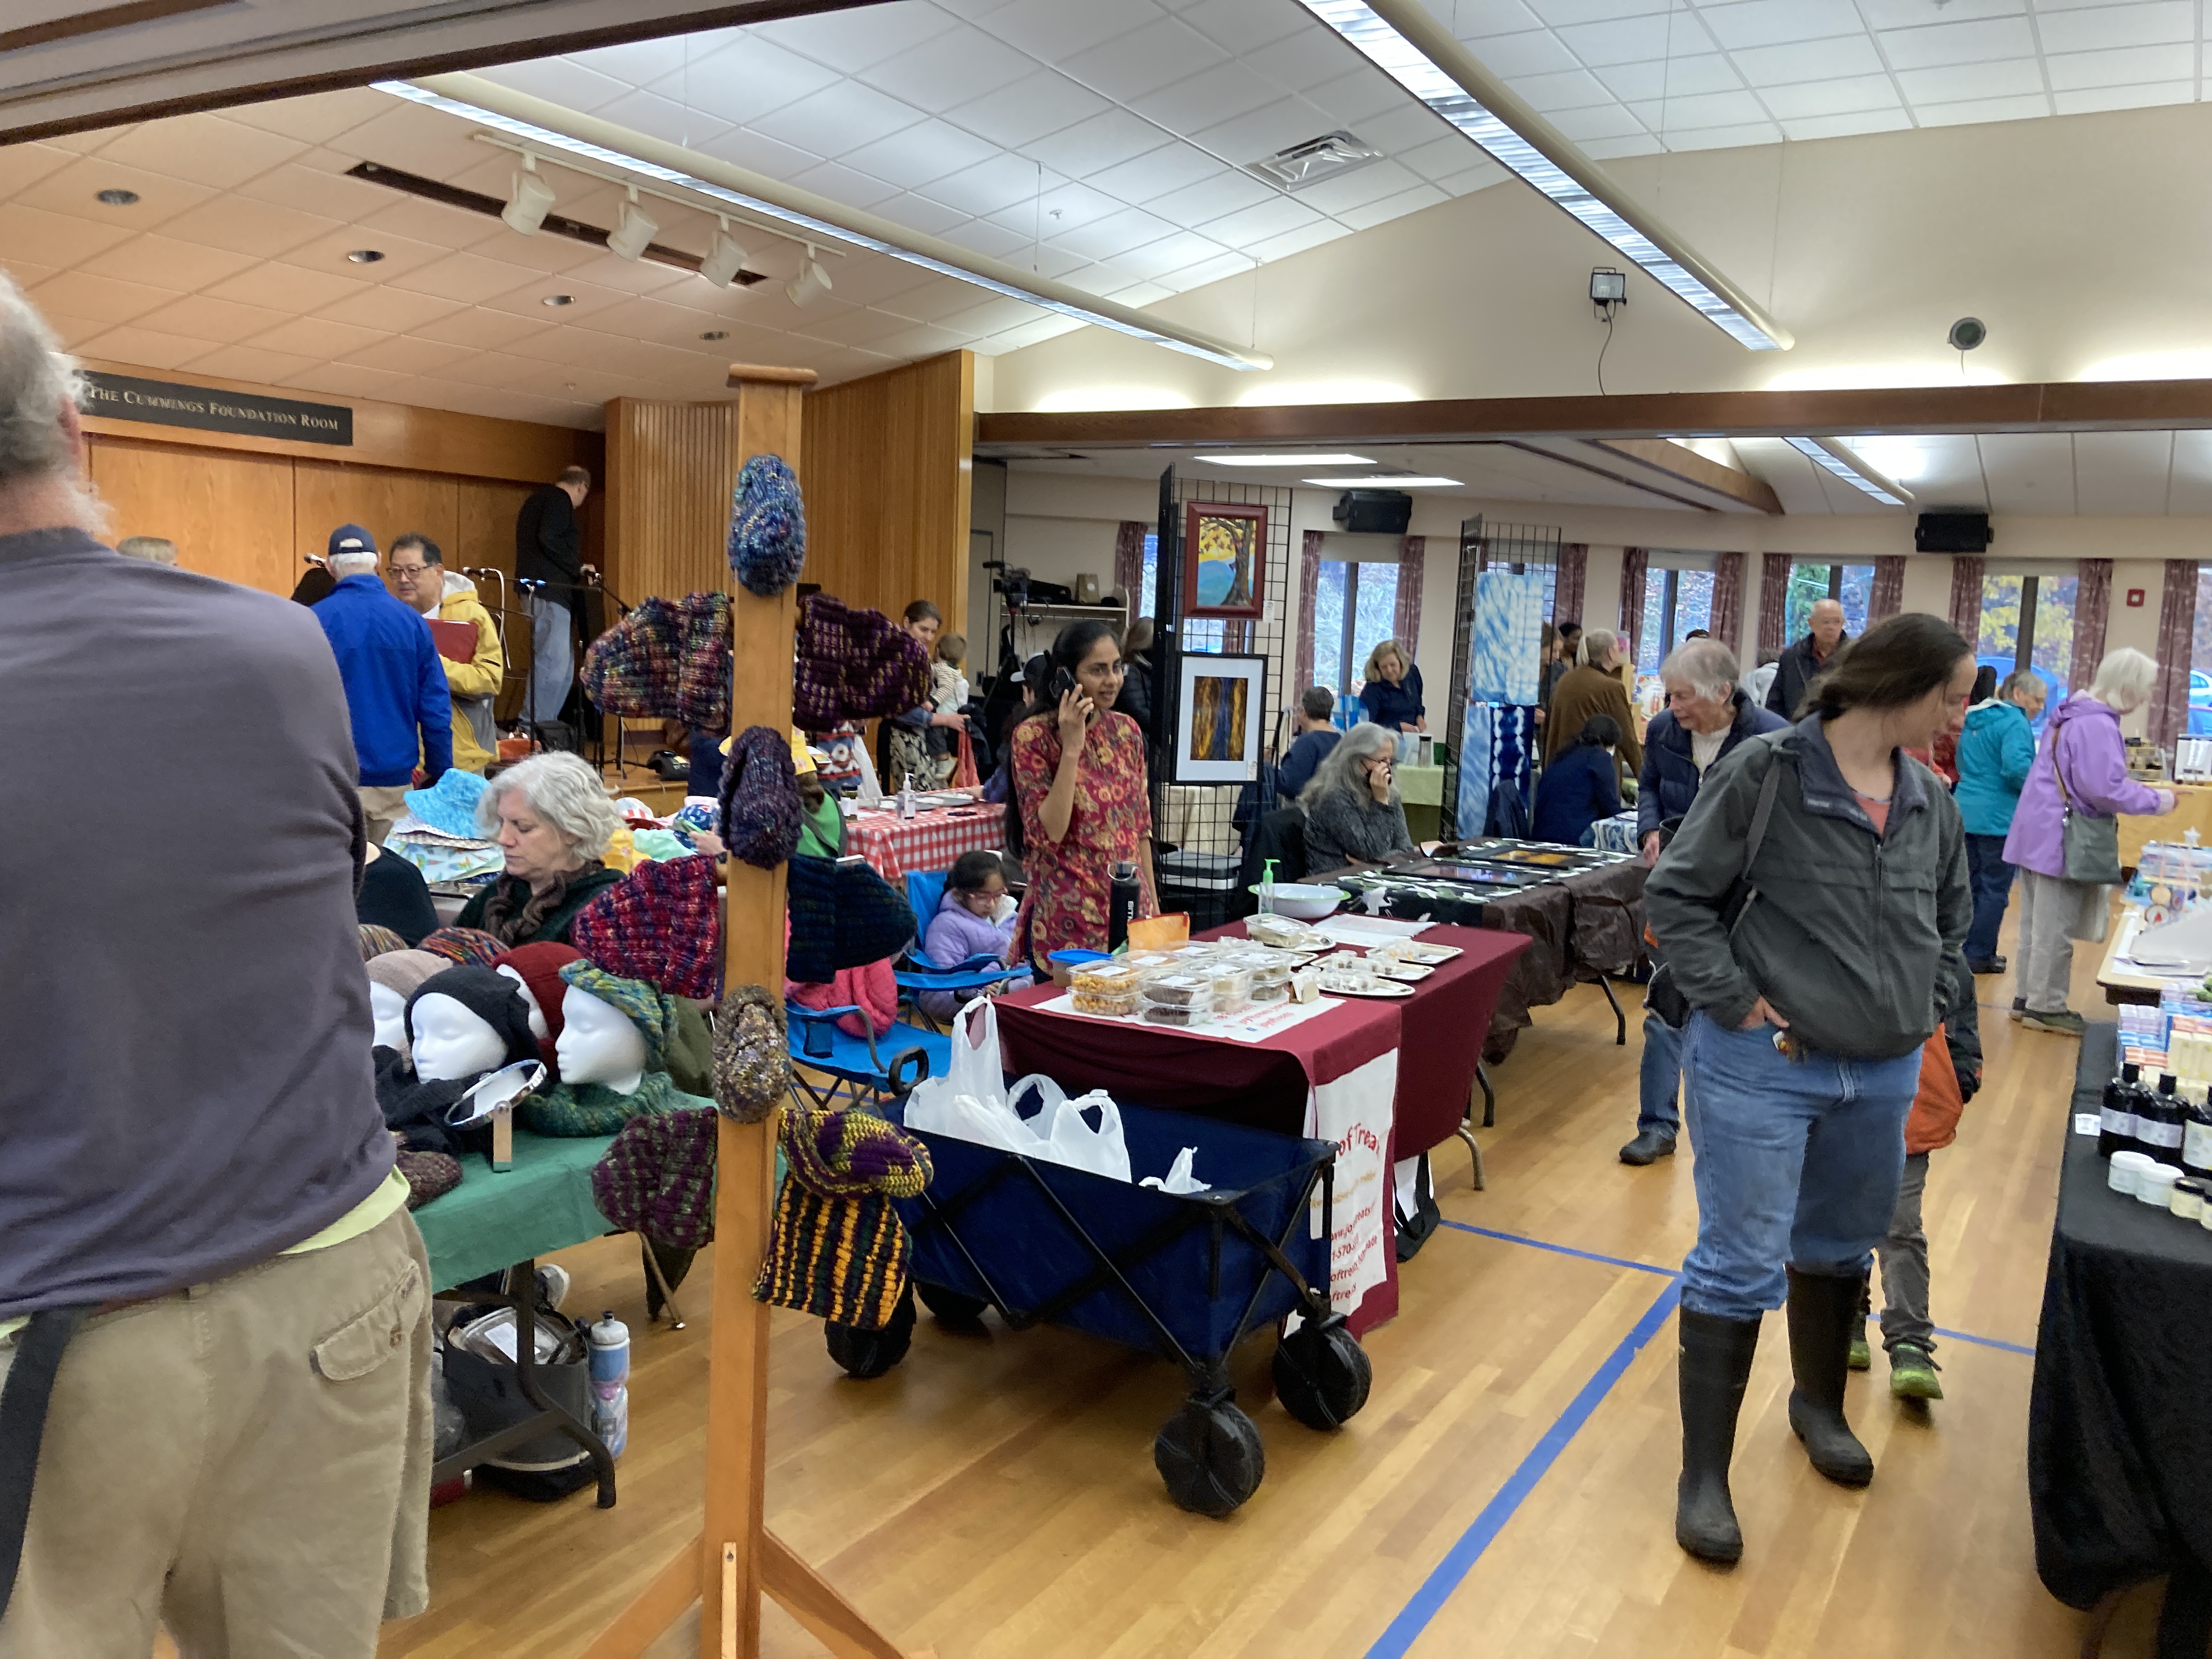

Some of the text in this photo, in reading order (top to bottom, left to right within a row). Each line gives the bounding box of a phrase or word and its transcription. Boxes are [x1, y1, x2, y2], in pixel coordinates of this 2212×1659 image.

[89, 386, 338, 430] THE CUMMINGS FOUNDATION ROOM
